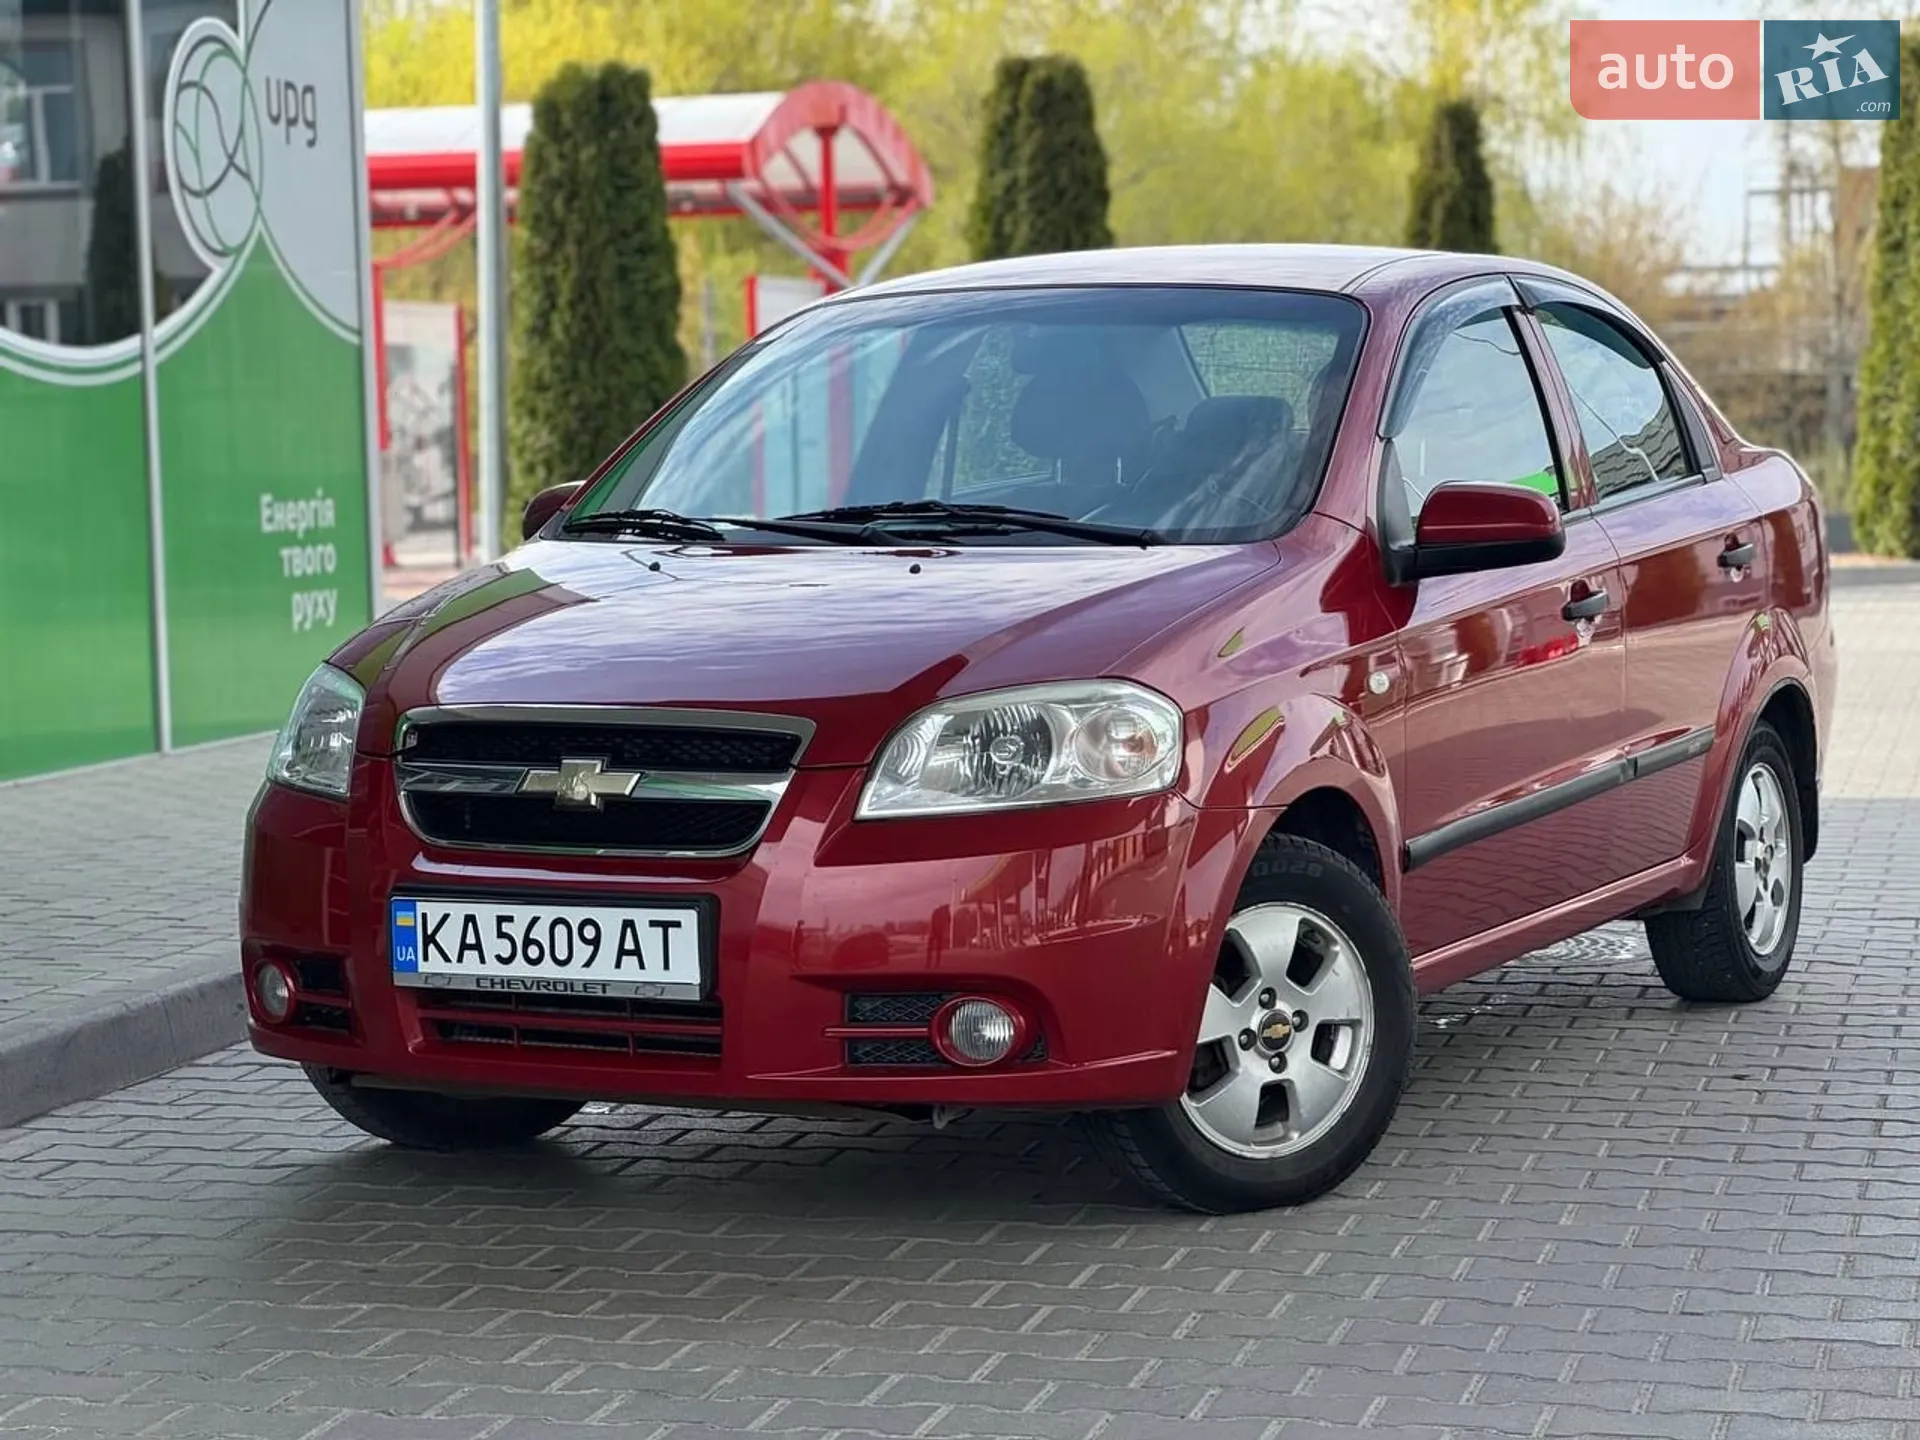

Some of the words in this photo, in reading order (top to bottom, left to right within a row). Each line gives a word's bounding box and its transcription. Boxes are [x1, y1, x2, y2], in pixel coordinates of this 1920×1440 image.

[265, 74, 318, 149] upg
[259, 486, 336, 540] Енергія
[279, 542, 337, 577] твого
[291, 587, 338, 632] руху
[396, 946, 416, 962] UA
[475, 976, 612, 995] CHEVROLET
